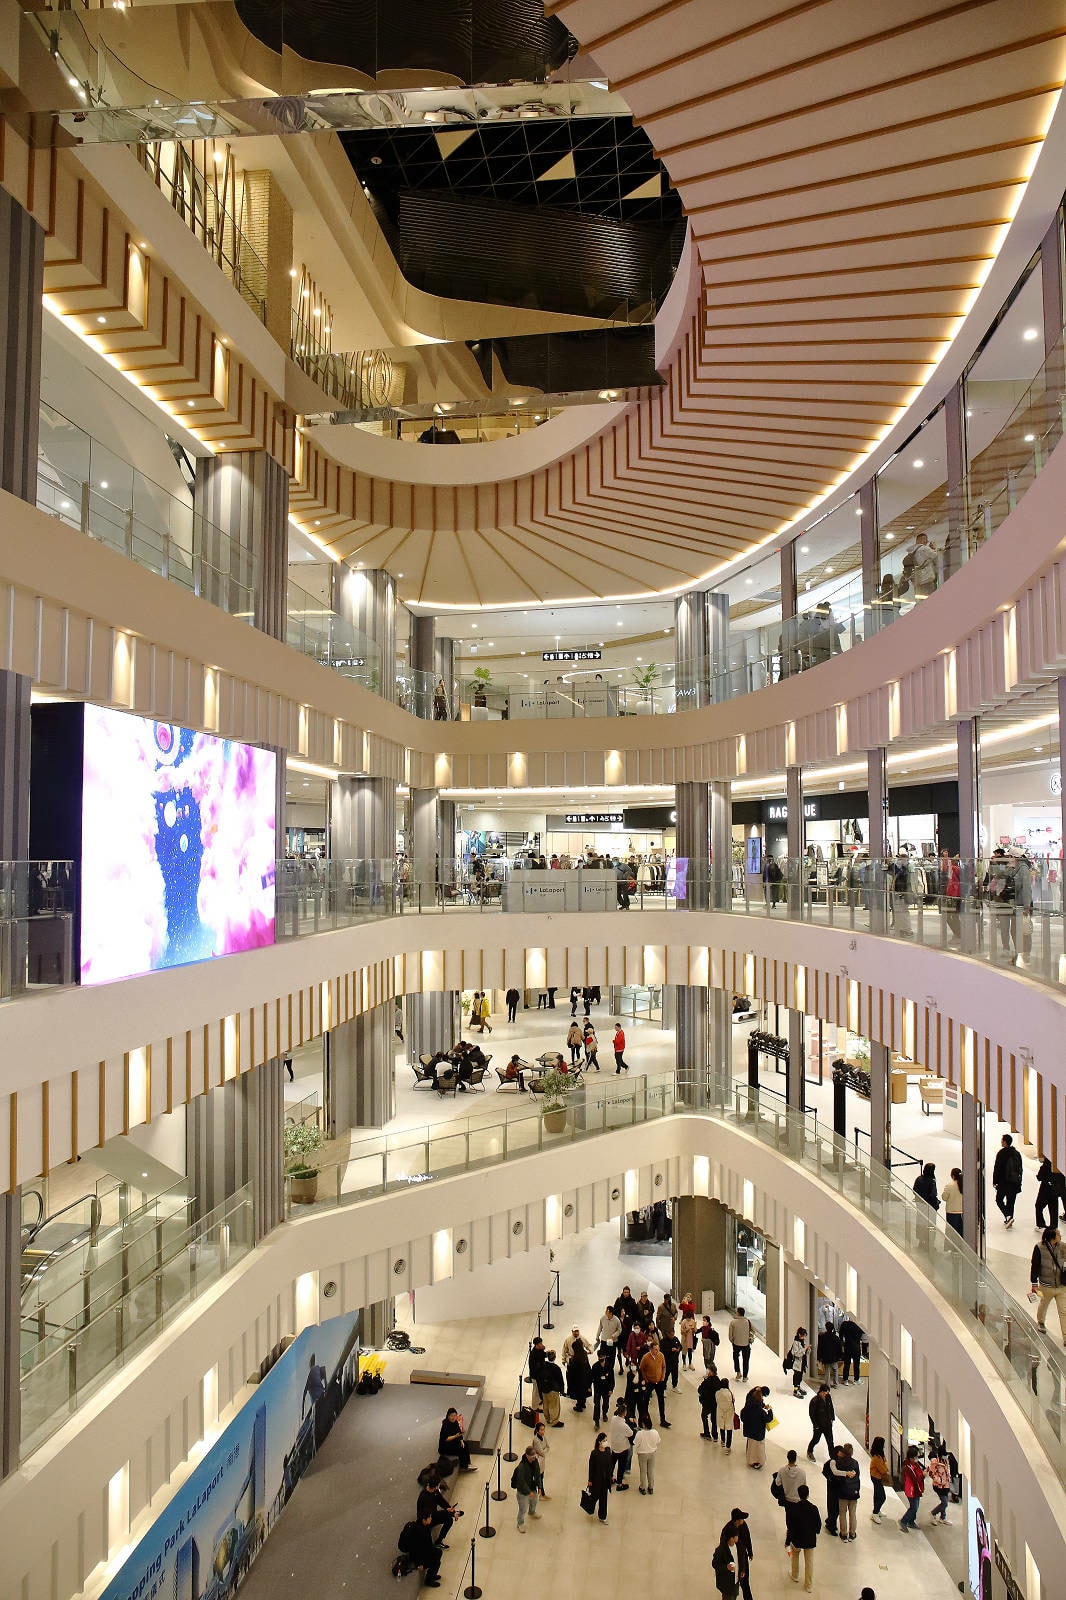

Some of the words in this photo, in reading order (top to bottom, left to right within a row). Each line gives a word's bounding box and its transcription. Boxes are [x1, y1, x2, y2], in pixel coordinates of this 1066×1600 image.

[769, 804, 817, 819] RAGUE
[128, 1553, 162, 1600] pping
[164, 1519, 185, 1557] Park
[187, 1466, 224, 1524] LaLaport
